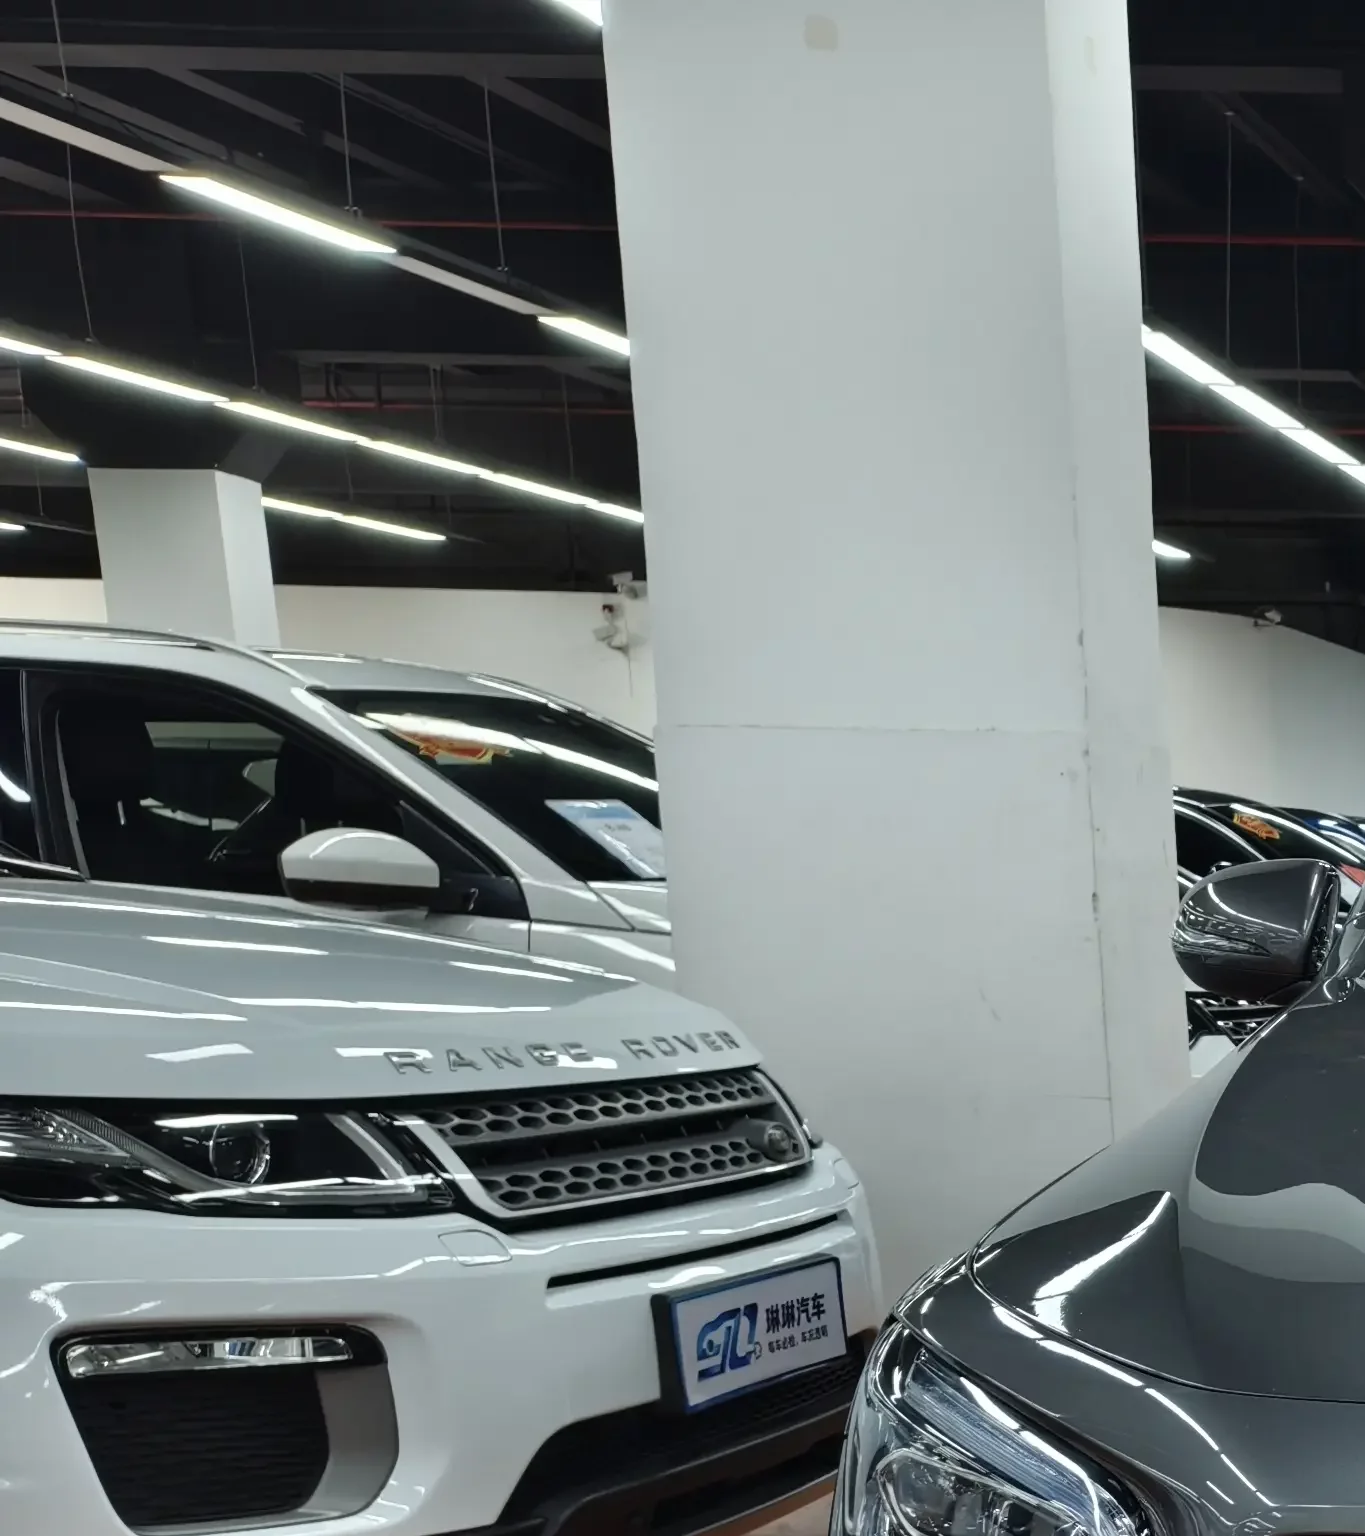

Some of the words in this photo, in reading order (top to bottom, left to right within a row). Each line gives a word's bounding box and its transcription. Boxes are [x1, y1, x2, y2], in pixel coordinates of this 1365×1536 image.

[383, 1042, 596, 1075] RANGE
[621, 1029, 742, 1060] ROVER
[765, 1292, 827, 1335] 琳琳汽车
